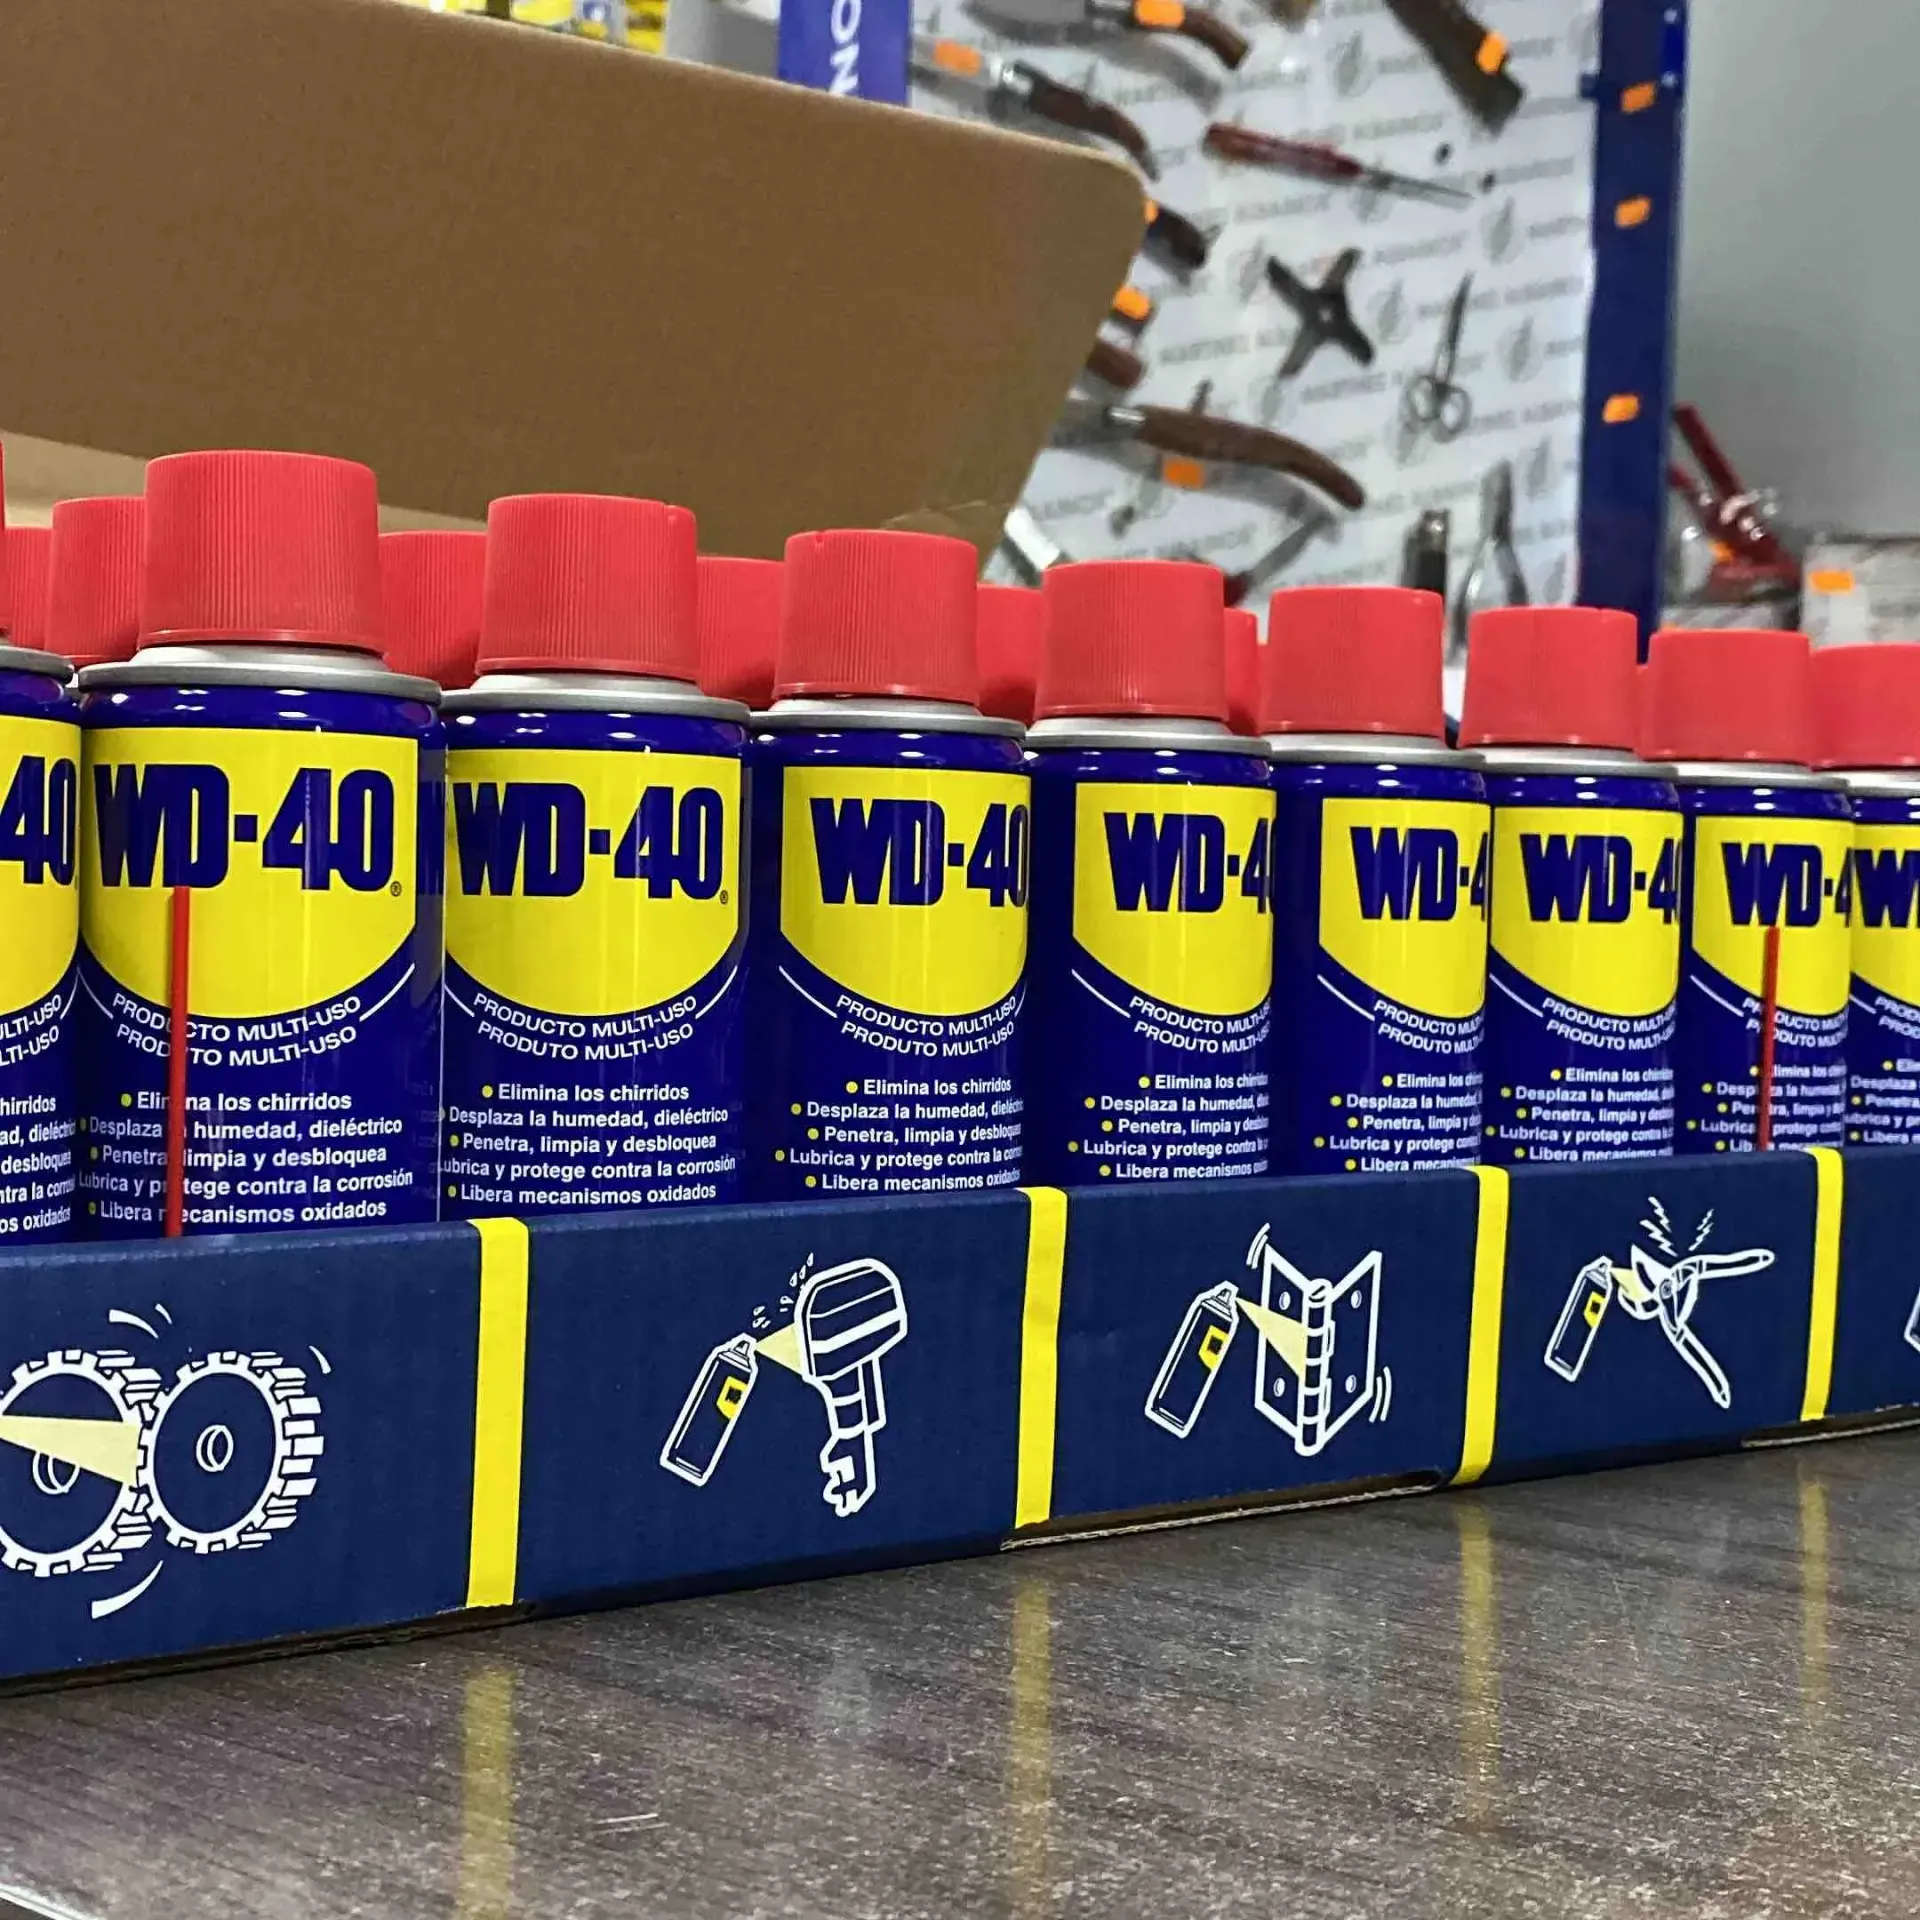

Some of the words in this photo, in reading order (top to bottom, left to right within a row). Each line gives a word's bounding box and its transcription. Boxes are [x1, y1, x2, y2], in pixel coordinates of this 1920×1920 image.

[94, 764, 395, 891] WD-40
[453, 782, 723, 899] WD-40
[810, 797, 1027, 907] WD-40
[1104, 812, 1276, 914] WD-4
[1519, 833, 1680, 924] WD-4
[238, 996, 360, 1044] MULTI-USO
[473, 993, 586, 1040] PRODUCTO
[592, 996, 696, 1040] MULTI-USO
[836, 995, 944, 1039] PRODUCTO
[949, 996, 1016, 1039] MULTI-USO
[1129, 996, 1224, 1037] PRODUCTO
[1374, 1000, 1456, 1039] PRODUCTO
[1542, 997, 1630, 1036] PRODUCTO
[117, 1021, 225, 1066] PRODTO
[229, 1023, 356, 1066] MULTI-USO
[478, 1019, 581, 1060] PRODUTO
[585, 1020, 693, 1061] MULTI-USO
[841, 1018, 940, 1056] PRODUTO
[943, 1019, 1014, 1057] MULTI-USO
[1134, 1018, 1221, 1053] PRODUTO
[1378, 1020, 1455, 1054] PRODUTO
[1547, 1016, 1628, 1050] PRODUTO
[1155, 1074, 1212, 1089] Elimina
[1216, 1074, 1234, 1088] los
[1397, 1073, 1446, 1088] Elimina
[1449, 1074, 1464, 1087] los
[1565, 1067, 1619, 1082] Elimina
[1622, 1068, 1640, 1082] los
[499, 1084, 568, 1101] Elimina
[575, 1085, 604, 1101] los
[610, 1084, 689, 1101] chirridos
[864, 1079, 929, 1095] Elimina
[934, 1079, 958, 1095] los
[962, 1077, 1011, 1094] chirridos
[1516, 1086, 1587, 1104] Desplaza
[1591, 1089, 1604, 1102] la
[218, 1093, 251, 1111] los
[258, 1092, 352, 1111] chirridos
[807, 1101, 889, 1122] Desplaza
[895, 1104, 910, 1119] la
[915, 1102, 988, 1119] humedad,
[1101, 1096, 1177, 1115] Desplaza
[1182, 1097, 1196, 1111] la
[1200, 1095, 1255, 1111] humedad,
[1347, 1094, 1417, 1112] Desplaza
[1421, 1095, 1433, 1109] la
[450, 1106, 523, 1128] Desplaza
[530, 1110, 546, 1126] la
[553, 1110, 648, 1129] humedad,
[654, 1107, 728, 1126] dieléctrico
[1363, 1115, 1425, 1131] Penetra,
[1428, 1115, 1461, 1132] limpia
[1532, 1106, 1595, 1123] Penetra,
[1599, 1108, 1637, 1125] limpia
[1640, 1111, 1646, 1124] y
[1894, 1116, 1903, 1128] y
[91, 1117, 162, 1140] Desplaza
[194, 1121, 302, 1141] humedad,
[309, 1117, 402, 1138] dieléctrico
[825, 1126, 899, 1145] Penetra,
[905, 1127, 954, 1146] limpia
[958, 1130, 967, 1145] y
[1118, 1118, 1186, 1136] Penetra,
[1191, 1119, 1231, 1137] limpia
[1234, 1121, 1241, 1135] y
[1500, 1125, 1559, 1141] Lubrica
[1562, 1131, 1572, 1145] y
[1576, 1129, 1629, 1145] protege
[1863, 1131, 1909, 1144] Libera
[463, 1133, 534, 1155] Penetra,
[541, 1136, 600, 1157] limpia
[606, 1140, 617, 1157] y
[623, 1135, 716, 1153] desbloquea
[1084, 1140, 1144, 1156] Lubrica
[1152, 1145, 1162, 1159] y
[1166, 1142, 1222, 1159] protege
[1226, 1140, 1256, 1154] contra
[1330, 1136, 1390, 1151] Lubrica
[1394, 1140, 1403, 1154] y
[1407, 1137, 1454, 1154] protege
[1530, 1146, 1578, 1162] Libera
[183, 1149, 246, 1172] limpia
[253, 1153, 266, 1171] y
[272, 1147, 386, 1168] desbloquea
[444, 1158, 489, 1175] ubrica
[495, 1164, 505, 1180] y
[511, 1163, 585, 1182] protege
[591, 1162, 652, 1178] contra
[658, 1160, 672, 1176] la
[677, 1154, 735, 1175] corrosión
[790, 1148, 854, 1166] Lubrica
[860, 1155, 871, 1170] y
[876, 1152, 943, 1171] protege
[947, 1150, 990, 1166] contra
[993, 1147, 1002, 1162] la
[1361, 1157, 1409, 1173] Libera
[1116, 1163, 1168, 1178] Libera
[1175, 1163, 1252, 1178] mecanismos
[32, 1182, 44, 1200] la
[80, 1173, 128, 1191] Lubrica
[134, 1179, 144, 1196] y
[237, 1177, 307, 1195] contra
[313, 1175, 331, 1193] la
[337, 1168, 412, 1192] corrosión
[822, 1174, 878, 1190] Libera
[885, 1174, 983, 1190] mecanismos
[461, 1184, 512, 1202] Libera
[519, 1188, 642, 1204] mecanismos
[647, 1183, 716, 1203] oxidados
[101, 1201, 152, 1221] Libera
[301, 1200, 387, 1221] oxidados
